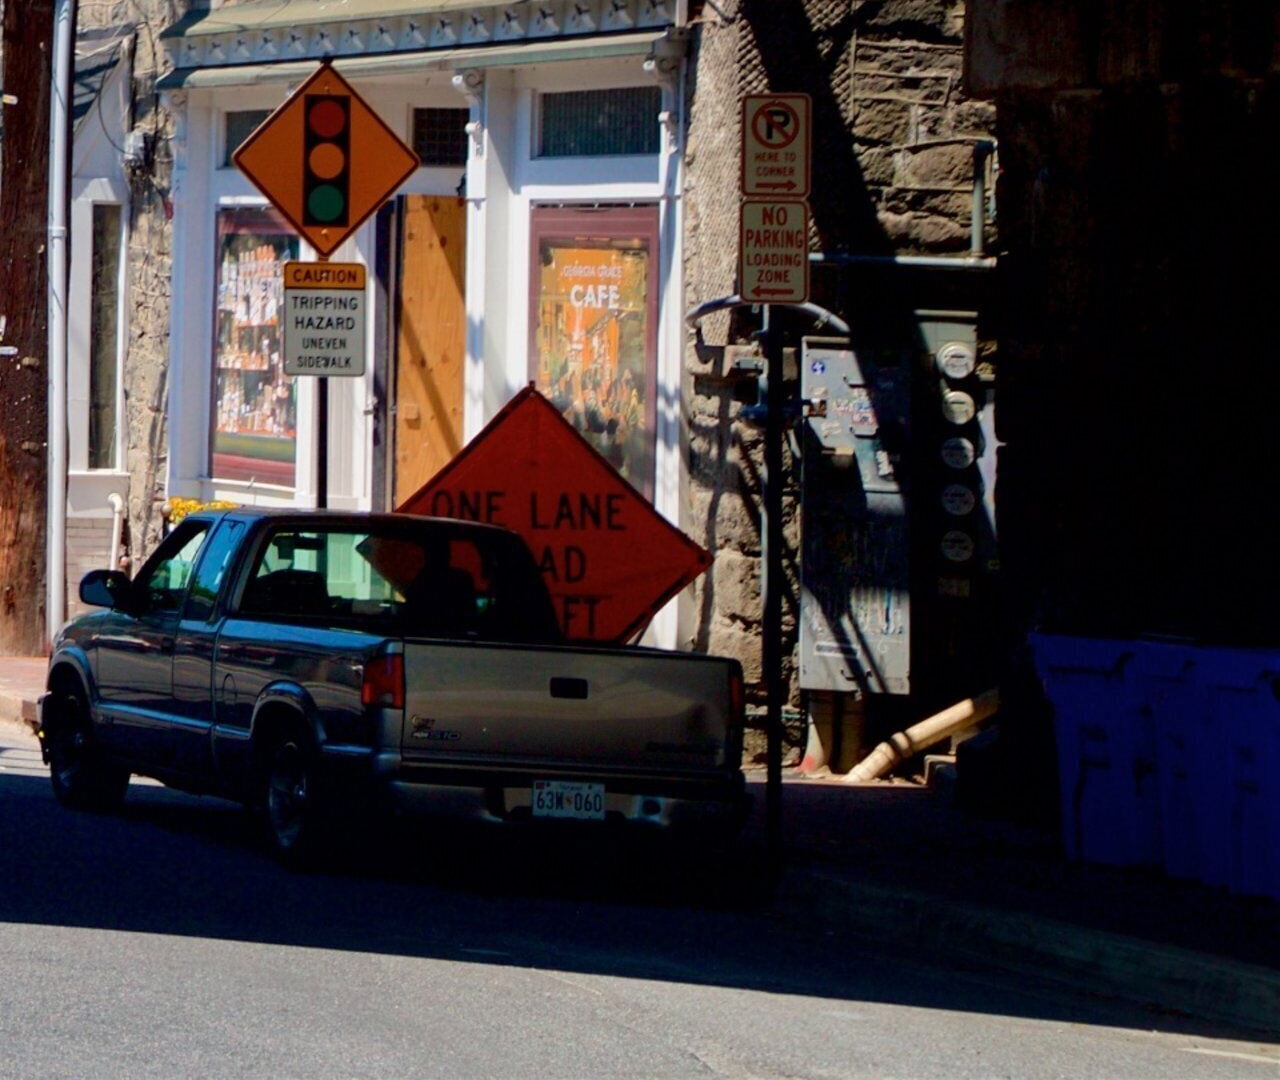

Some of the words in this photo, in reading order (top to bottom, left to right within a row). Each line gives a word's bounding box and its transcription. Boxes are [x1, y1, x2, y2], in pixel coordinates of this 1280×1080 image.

[754, 152, 781, 163] HERE
[783, 152, 797, 163] TO
[755, 166, 795, 177] CORNER
[761, 207, 788, 226] NO
[745, 229, 804, 249] PARKING
[746, 253, 802, 267] LOADING
[293, 268, 358, 285] CAUTION
[756, 270, 791, 283] ZONE
[291, 296, 358, 311] TRIPPING
[570, 284, 620, 309] CAFE
[294, 316, 355, 331] HAZARD
[302, 337, 347, 350] UNEVEN
[297, 355, 352, 369] SIDEWALK
[430, 490, 505, 526] ONE
[530, 491, 628, 530] LANE
[536, 545, 587, 583] AD
[563, 598, 606, 637] FT
[574, 793, 602, 812] 060
